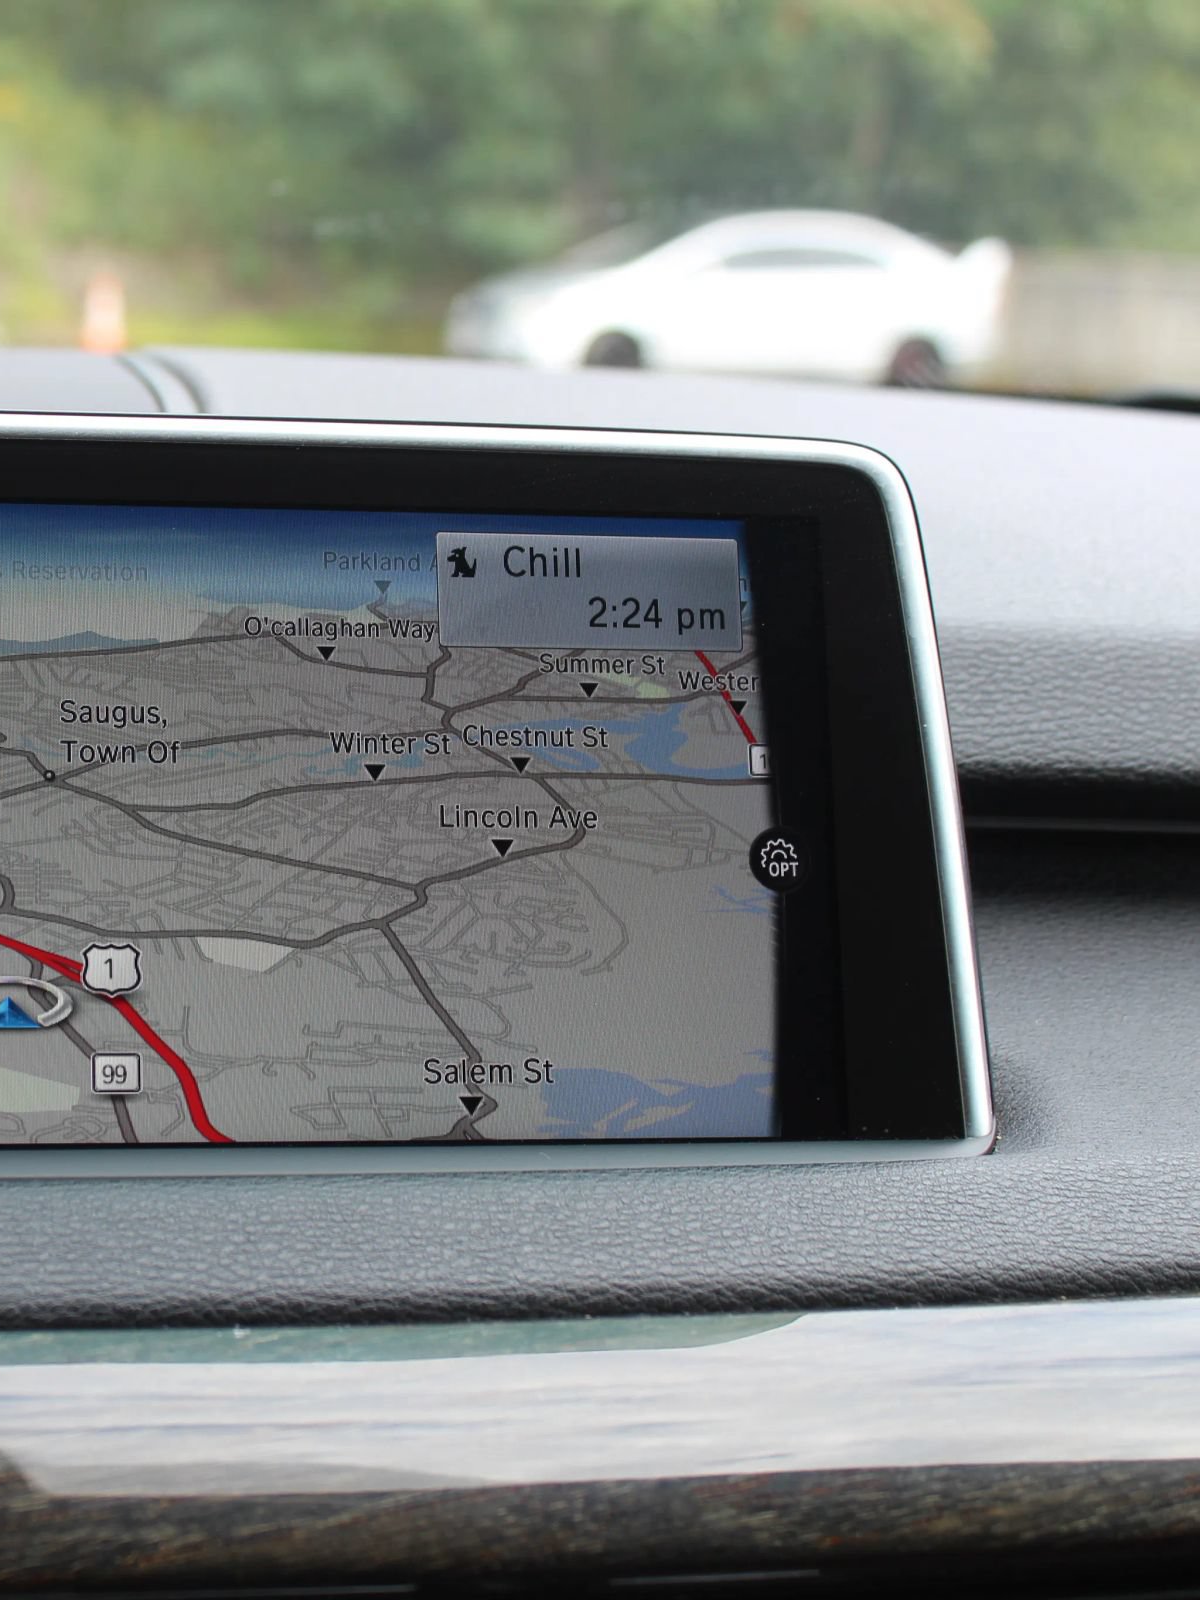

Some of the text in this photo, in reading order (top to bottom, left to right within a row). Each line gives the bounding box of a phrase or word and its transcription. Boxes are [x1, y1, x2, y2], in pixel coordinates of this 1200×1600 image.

[12, 561, 148, 582] Reservation
[323, 551, 420, 572] Parkland
[503, 546, 582, 578] Chill
[588, 597, 726, 636] 2:24 pm
[245, 617, 436, 643] O'callaghan Way
[539, 653, 666, 676] Summer St
[678, 670, 760, 692] Wester
[60, 699, 168, 729] Saugus,
[330, 731, 451, 755] Winter St
[463, 724, 609, 749] Chestnut St
[60, 740, 180, 764] Town Of
[439, 804, 598, 829] Lincoln Ave
[769, 861, 799, 878] OPT
[103, 958, 114, 980] 1
[101, 1064, 128, 1085] 99
[423, 1058, 555, 1085] Salem St
